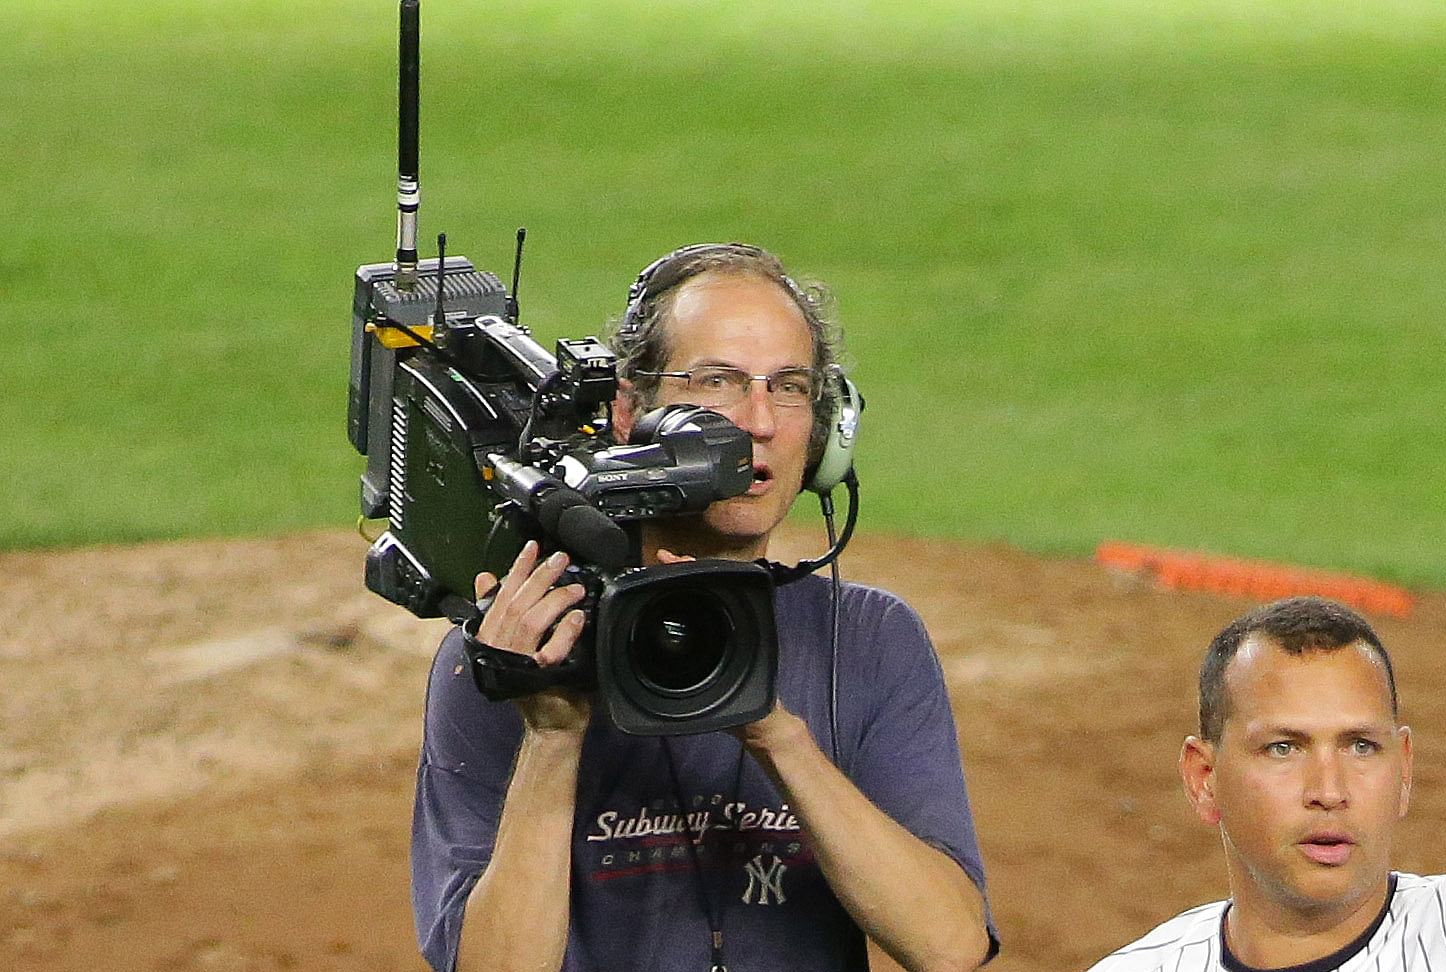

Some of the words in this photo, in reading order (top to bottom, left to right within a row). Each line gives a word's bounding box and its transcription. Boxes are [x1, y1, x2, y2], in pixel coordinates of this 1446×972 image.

[598, 473, 628, 482] SONY
[587, 806, 710, 845] Subway
[742, 855, 787, 905] NY
